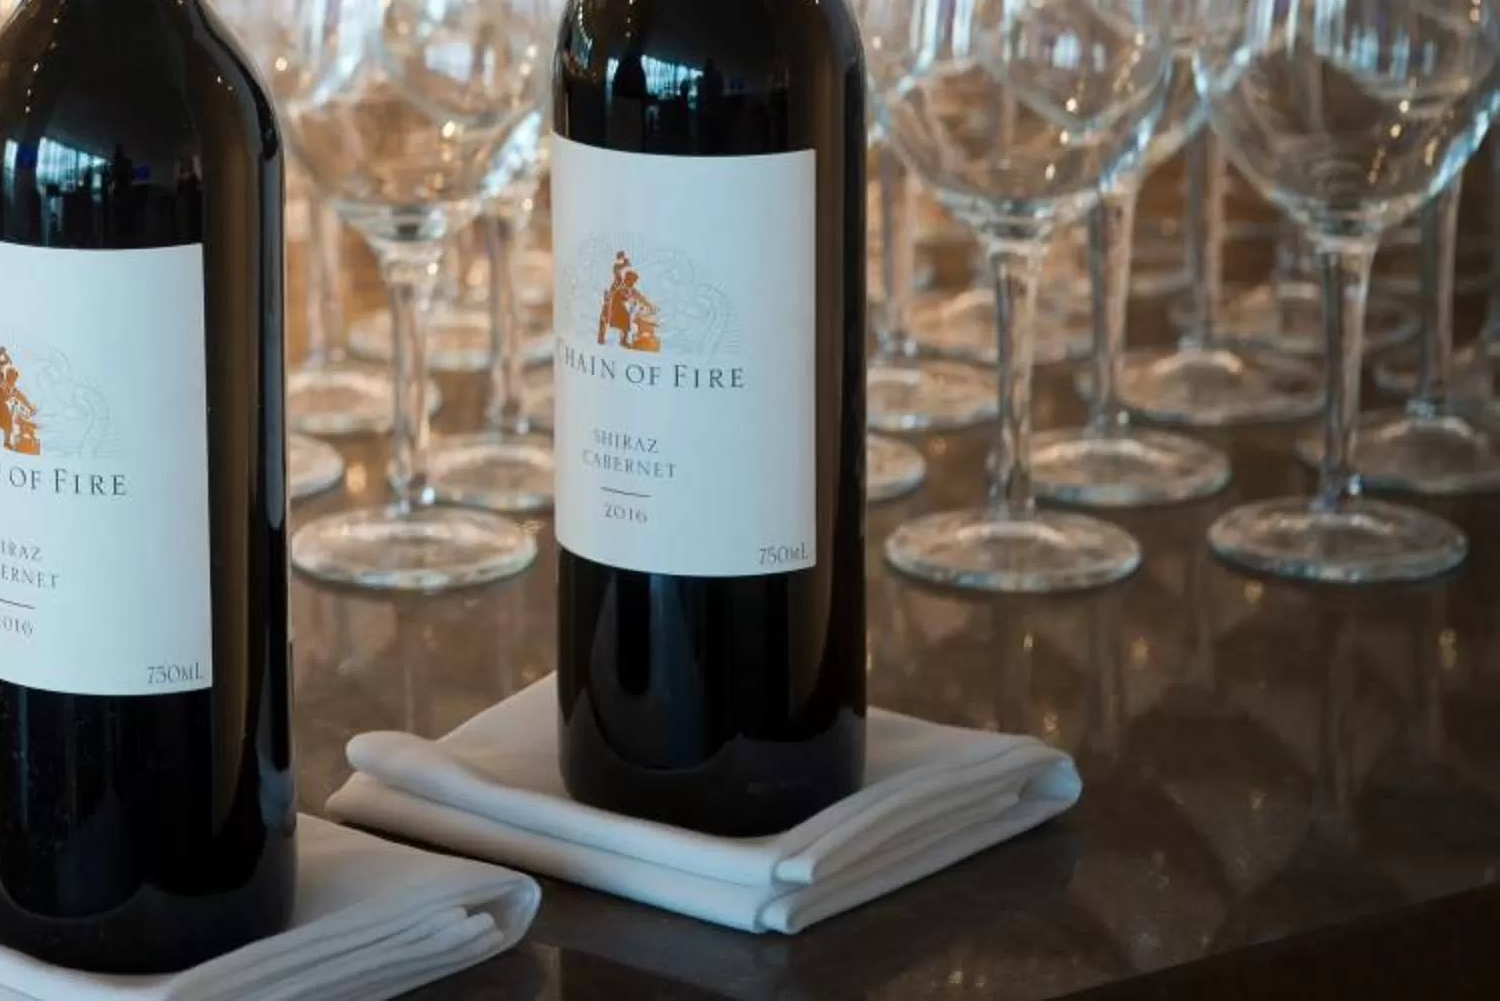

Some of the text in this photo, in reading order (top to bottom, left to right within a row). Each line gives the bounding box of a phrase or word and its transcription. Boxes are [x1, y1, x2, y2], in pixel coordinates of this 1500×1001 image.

[556, 338, 746, 389] CHAIN OF FIRE
[593, 428, 660, 453] SHIRAZ
[582, 450, 677, 478] CABERNET
[9, 465, 43, 490] OF
[53, 468, 128, 496] FIRE
[603, 502, 648, 524] 2016
